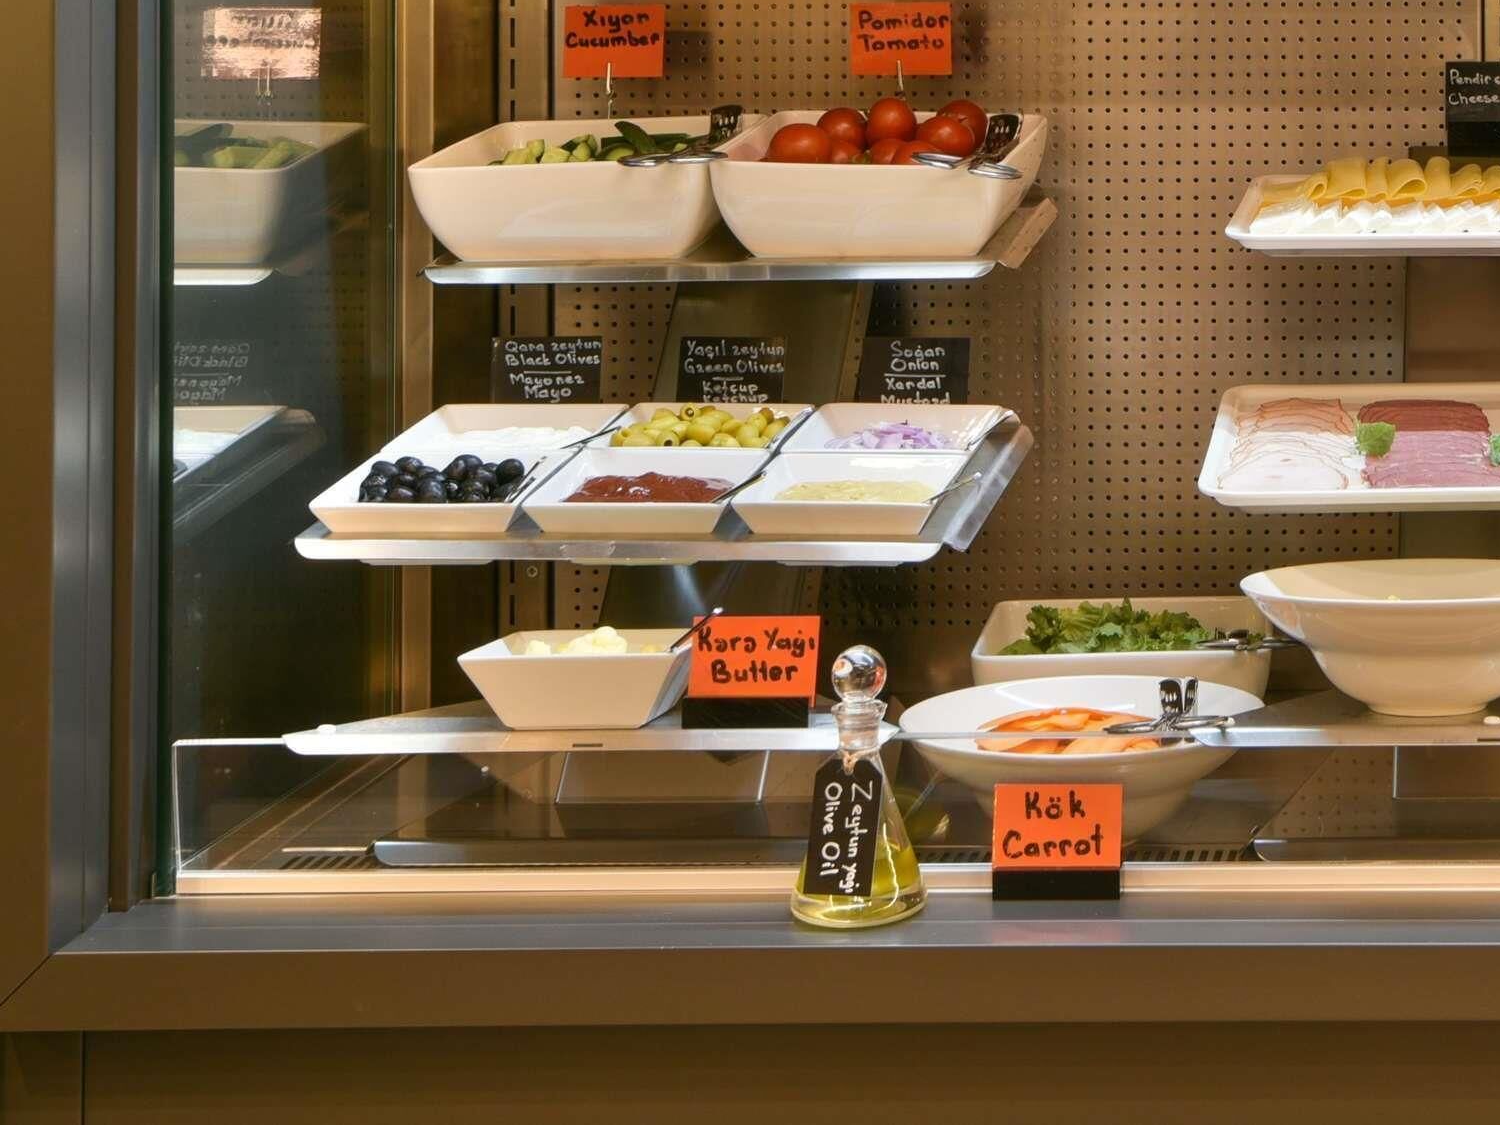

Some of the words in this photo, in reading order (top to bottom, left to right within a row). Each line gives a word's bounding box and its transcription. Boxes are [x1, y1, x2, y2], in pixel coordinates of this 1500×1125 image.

[858, 10, 949, 30] Pomidor
[565, 30, 661, 48] Cucumber
[857, 34, 945, 52] Tomato
[1449, 68, 1492, 86] Pendir
[1448, 92, 1500, 105] Cheese
[504, 341, 545, 353] Qara
[550, 338, 602, 354] zeytun
[505, 353, 552, 366] Black
[555, 353, 600, 365] Olives
[736, 359, 785, 373] Olives
[890, 358, 939, 372] Onion
[509, 373, 585, 387] Mayonez
[523, 385, 572, 404] Mayo
[711, 659, 799, 684] Butter
[823, 781, 843, 836] Olive
[1025, 790, 1086, 820] Kök
[845, 780, 873, 858] Zeytun
[1003, 823, 1104, 859] Carrot
[819, 841, 841, 876] Oil
